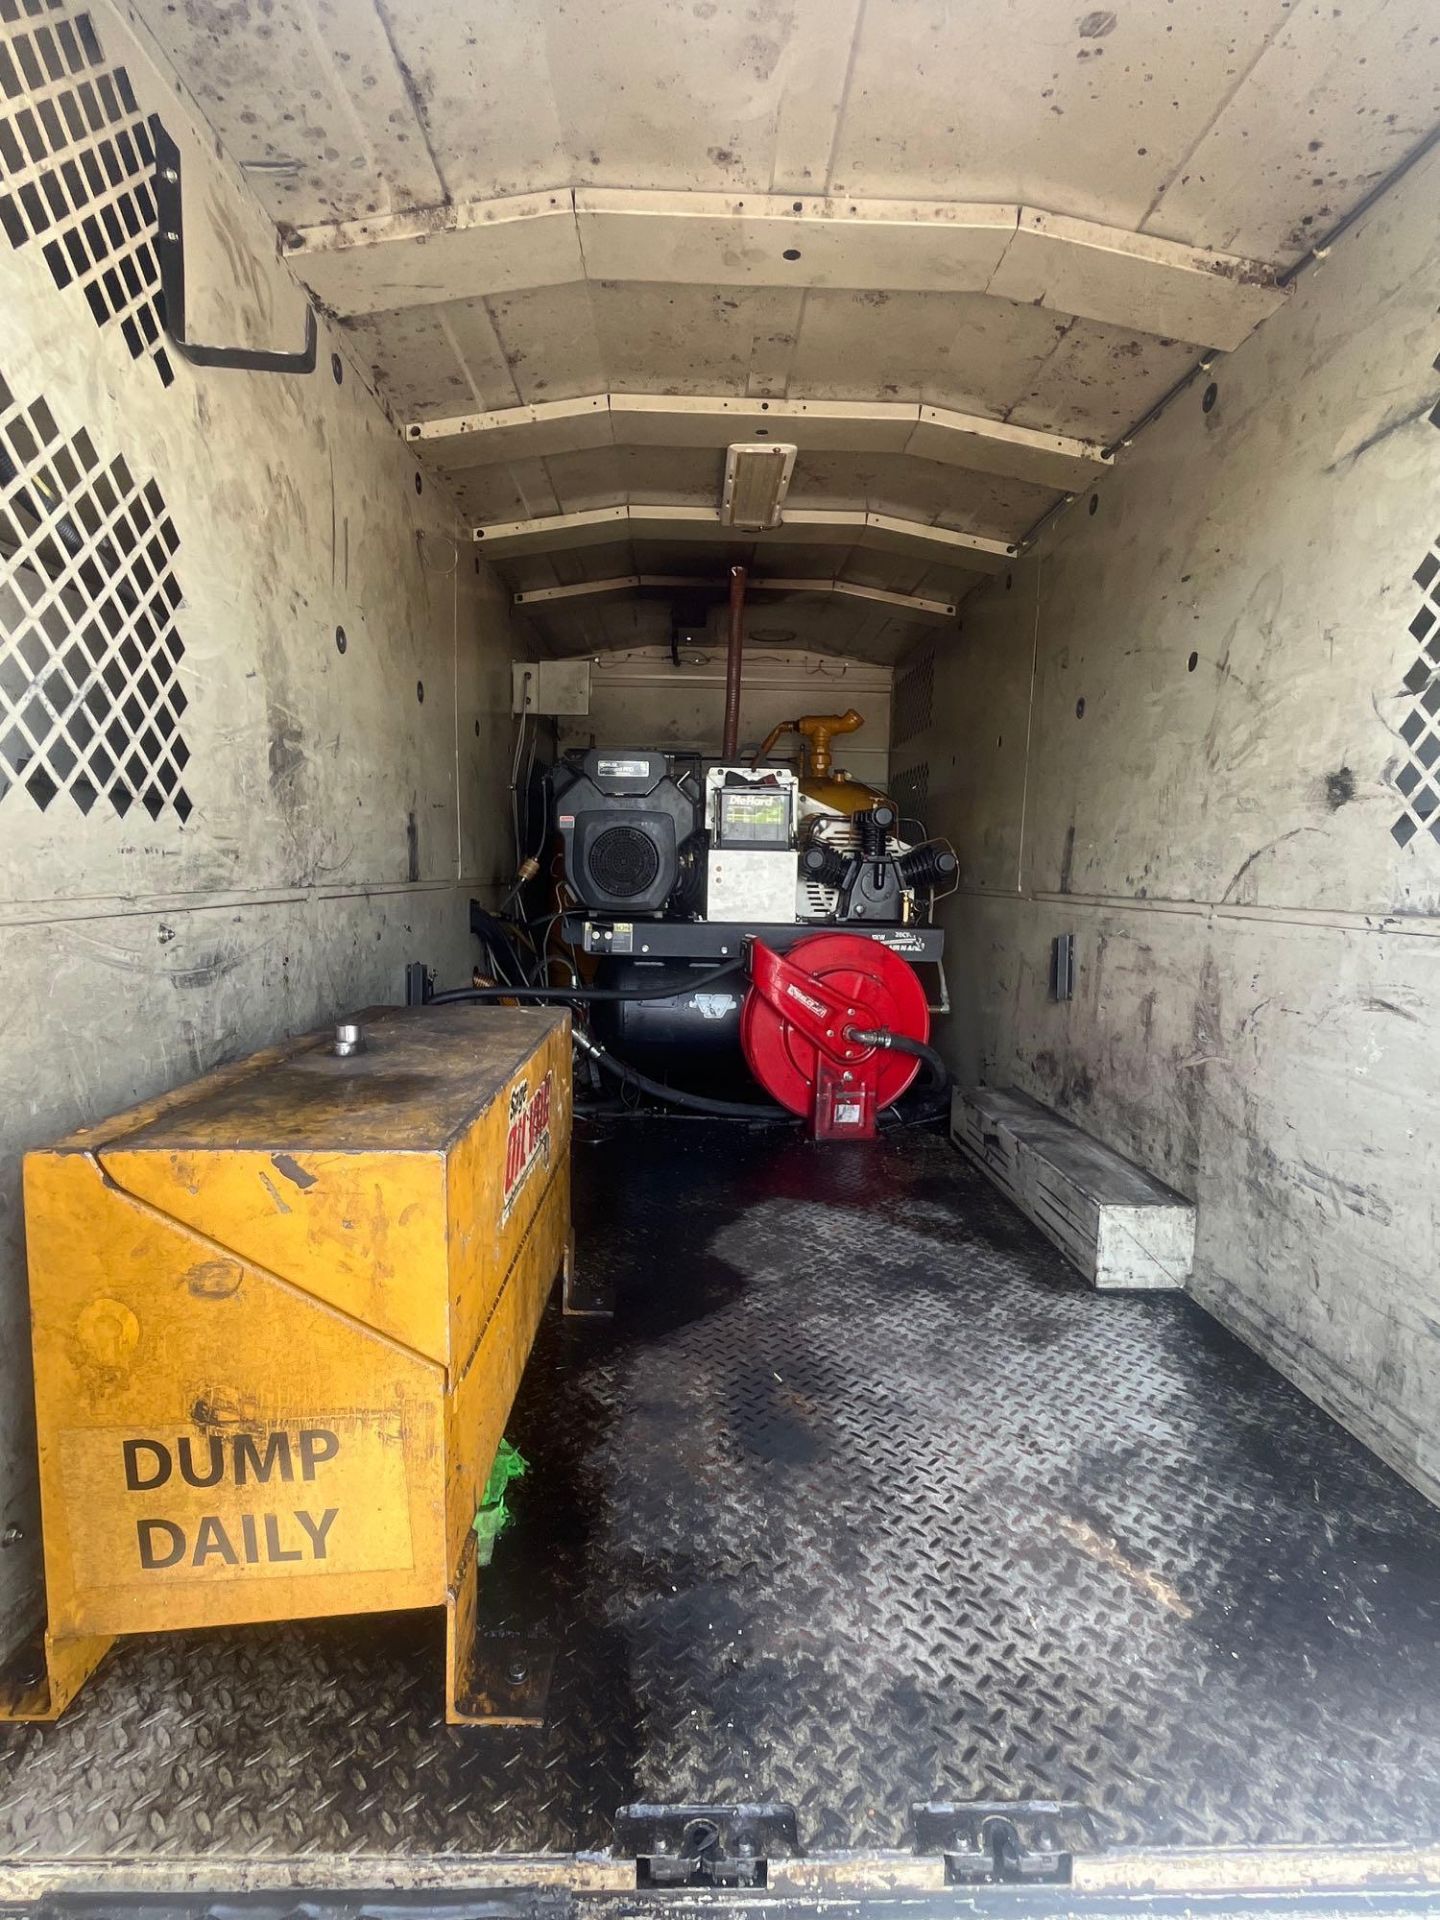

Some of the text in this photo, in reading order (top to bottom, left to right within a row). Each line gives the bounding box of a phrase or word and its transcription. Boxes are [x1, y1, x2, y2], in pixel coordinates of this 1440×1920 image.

[730, 796, 773, 807] DieHard
[122, 1428, 340, 1492] DUMP
[136, 1507, 340, 1570] DAILY
